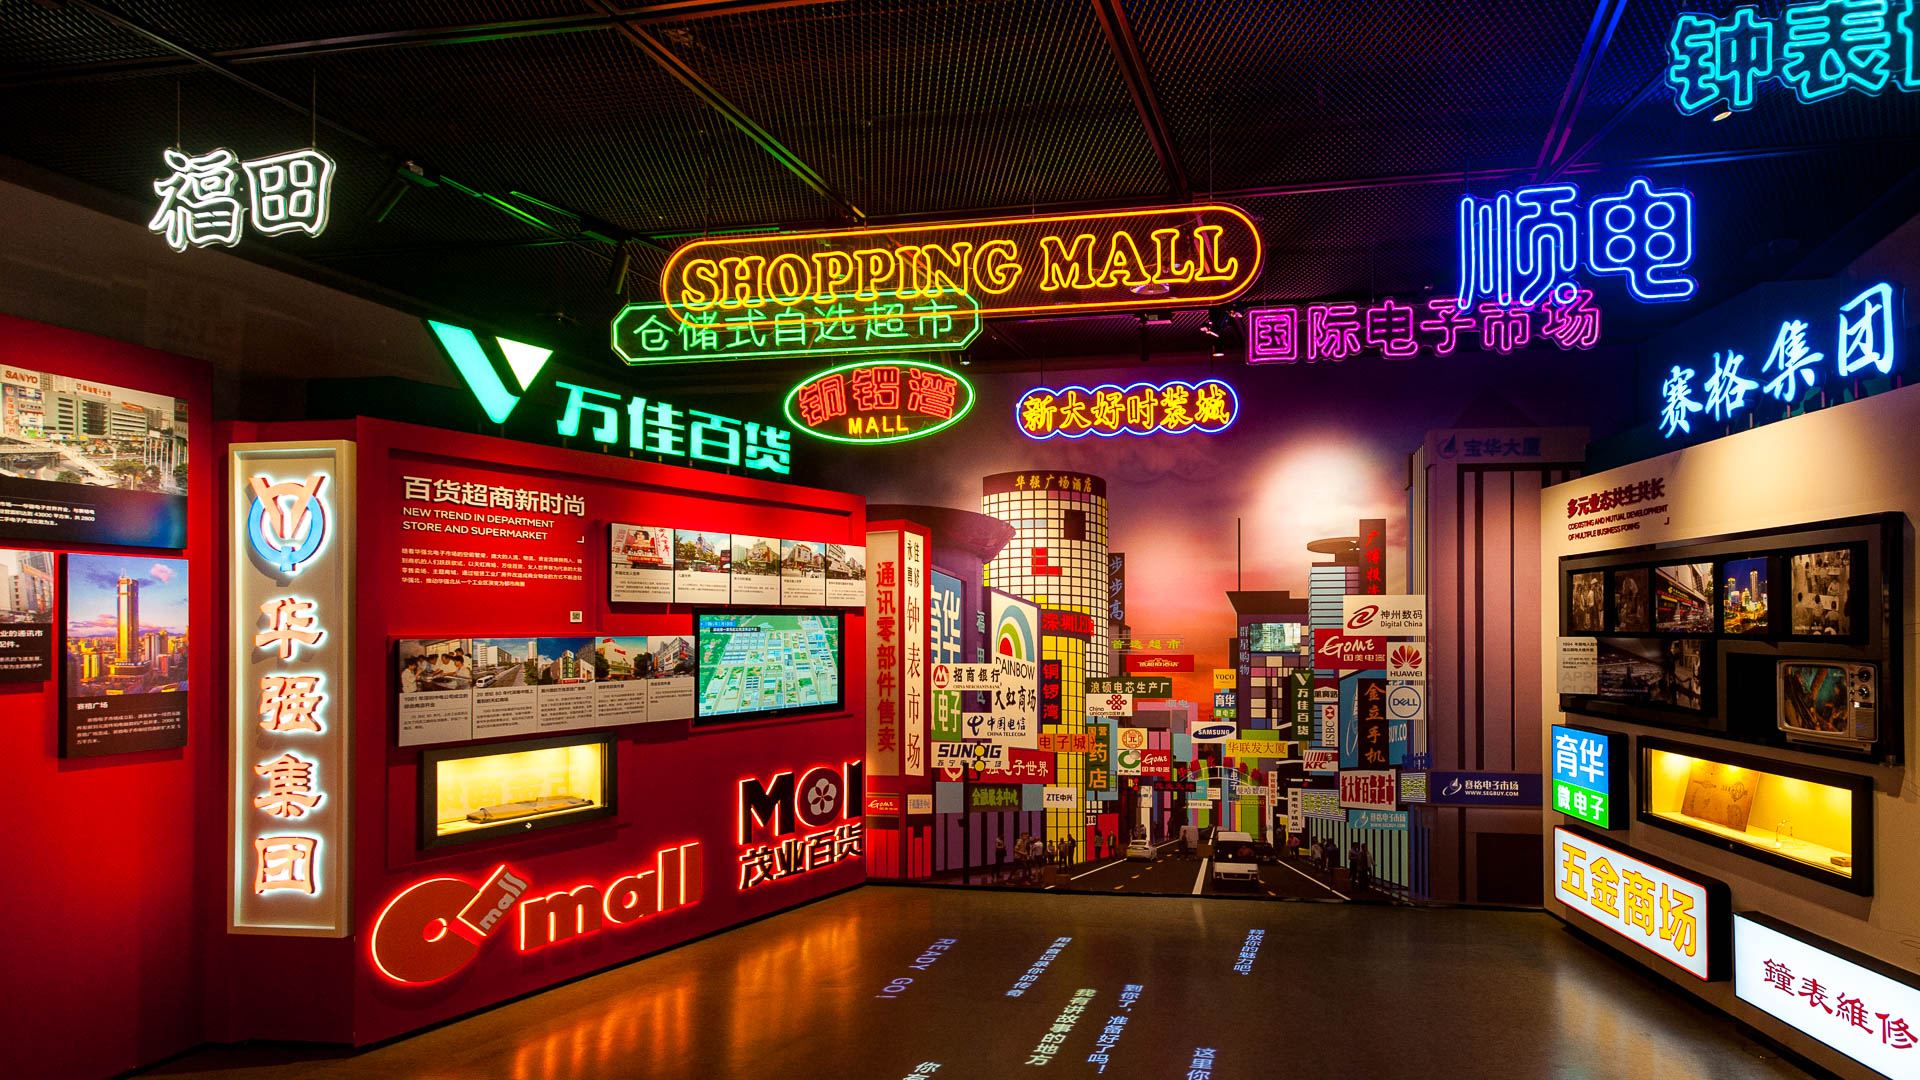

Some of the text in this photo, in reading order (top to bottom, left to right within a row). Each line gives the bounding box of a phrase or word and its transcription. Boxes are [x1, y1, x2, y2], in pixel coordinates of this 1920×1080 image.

[1666, 0, 1920, 116] 钟表
[148, 146, 336, 252] 福田
[1458, 177, 1696, 309] 顺电
[681, 224, 1239, 311] SHOPPING MALL
[632, 301, 957, 352] 仓储式自选超市
[1248, 289, 1600, 364] 国际电子市场
[4, 370, 39, 384] SANYO
[1660, 282, 1894, 438] 赛格集团
[799, 366, 957, 427] 铜锣湾
[1022, 382, 1232, 430] 新大好时装城
[556, 381, 791, 474] 万佳百货
[848, 415, 909, 435] MALL
[402, 475, 585, 517] 百货超商新时尚
[1015, 474, 1092, 493] 华强广场酒店
[402, 521, 548, 541] STORE AND SUPERMARKET
[403, 507, 555, 529] NEW TREND IN DEPARTMENT
[1568, 533, 1575, 541] OF
[1597, 525, 1620, 537] BUSINESS
[1626, 504, 1669, 519] DEVELOPMENT
[1109, 556, 1123, 621] 步步高
[1380, 610, 1423, 619] 神州数码
[1380, 620, 1402, 628] Digital
[876, 562, 897, 752] 通讯零部件售卖
[906, 595, 921, 769] 钟表市场
[1042, 663, 1060, 720] 铜锣湾
[1392, 697, 1418, 706] DELL
[931, 690, 961, 733] 电子
[987, 717, 1026, 731] 中国电信
[1325, 720, 1336, 746] HSBC
[1364, 683, 1386, 763] 金立手机
[254, 597, 326, 895] 华强集团
[1089, 743, 1108, 788] 药店
[1227, 742, 1286, 754] 华联发大厦
[1305, 761, 1328, 770] KFC
[1555, 736, 1605, 783] 育华
[1046, 793, 1073, 802] ZTE中兴
[1464, 779, 1520, 791] 赛格电子市场
[1557, 783, 1605, 822] 微电子
[739, 822, 863, 891] 茂业百货
[478, 876, 529, 931] mall
[1561, 841, 1697, 958] 五金商场
[874, 938, 959, 1000] READY GO!
[1024, 988, 1098, 1066] 我有讲故事的地方
[1762, 957, 1920, 1050] 鐘表維修
